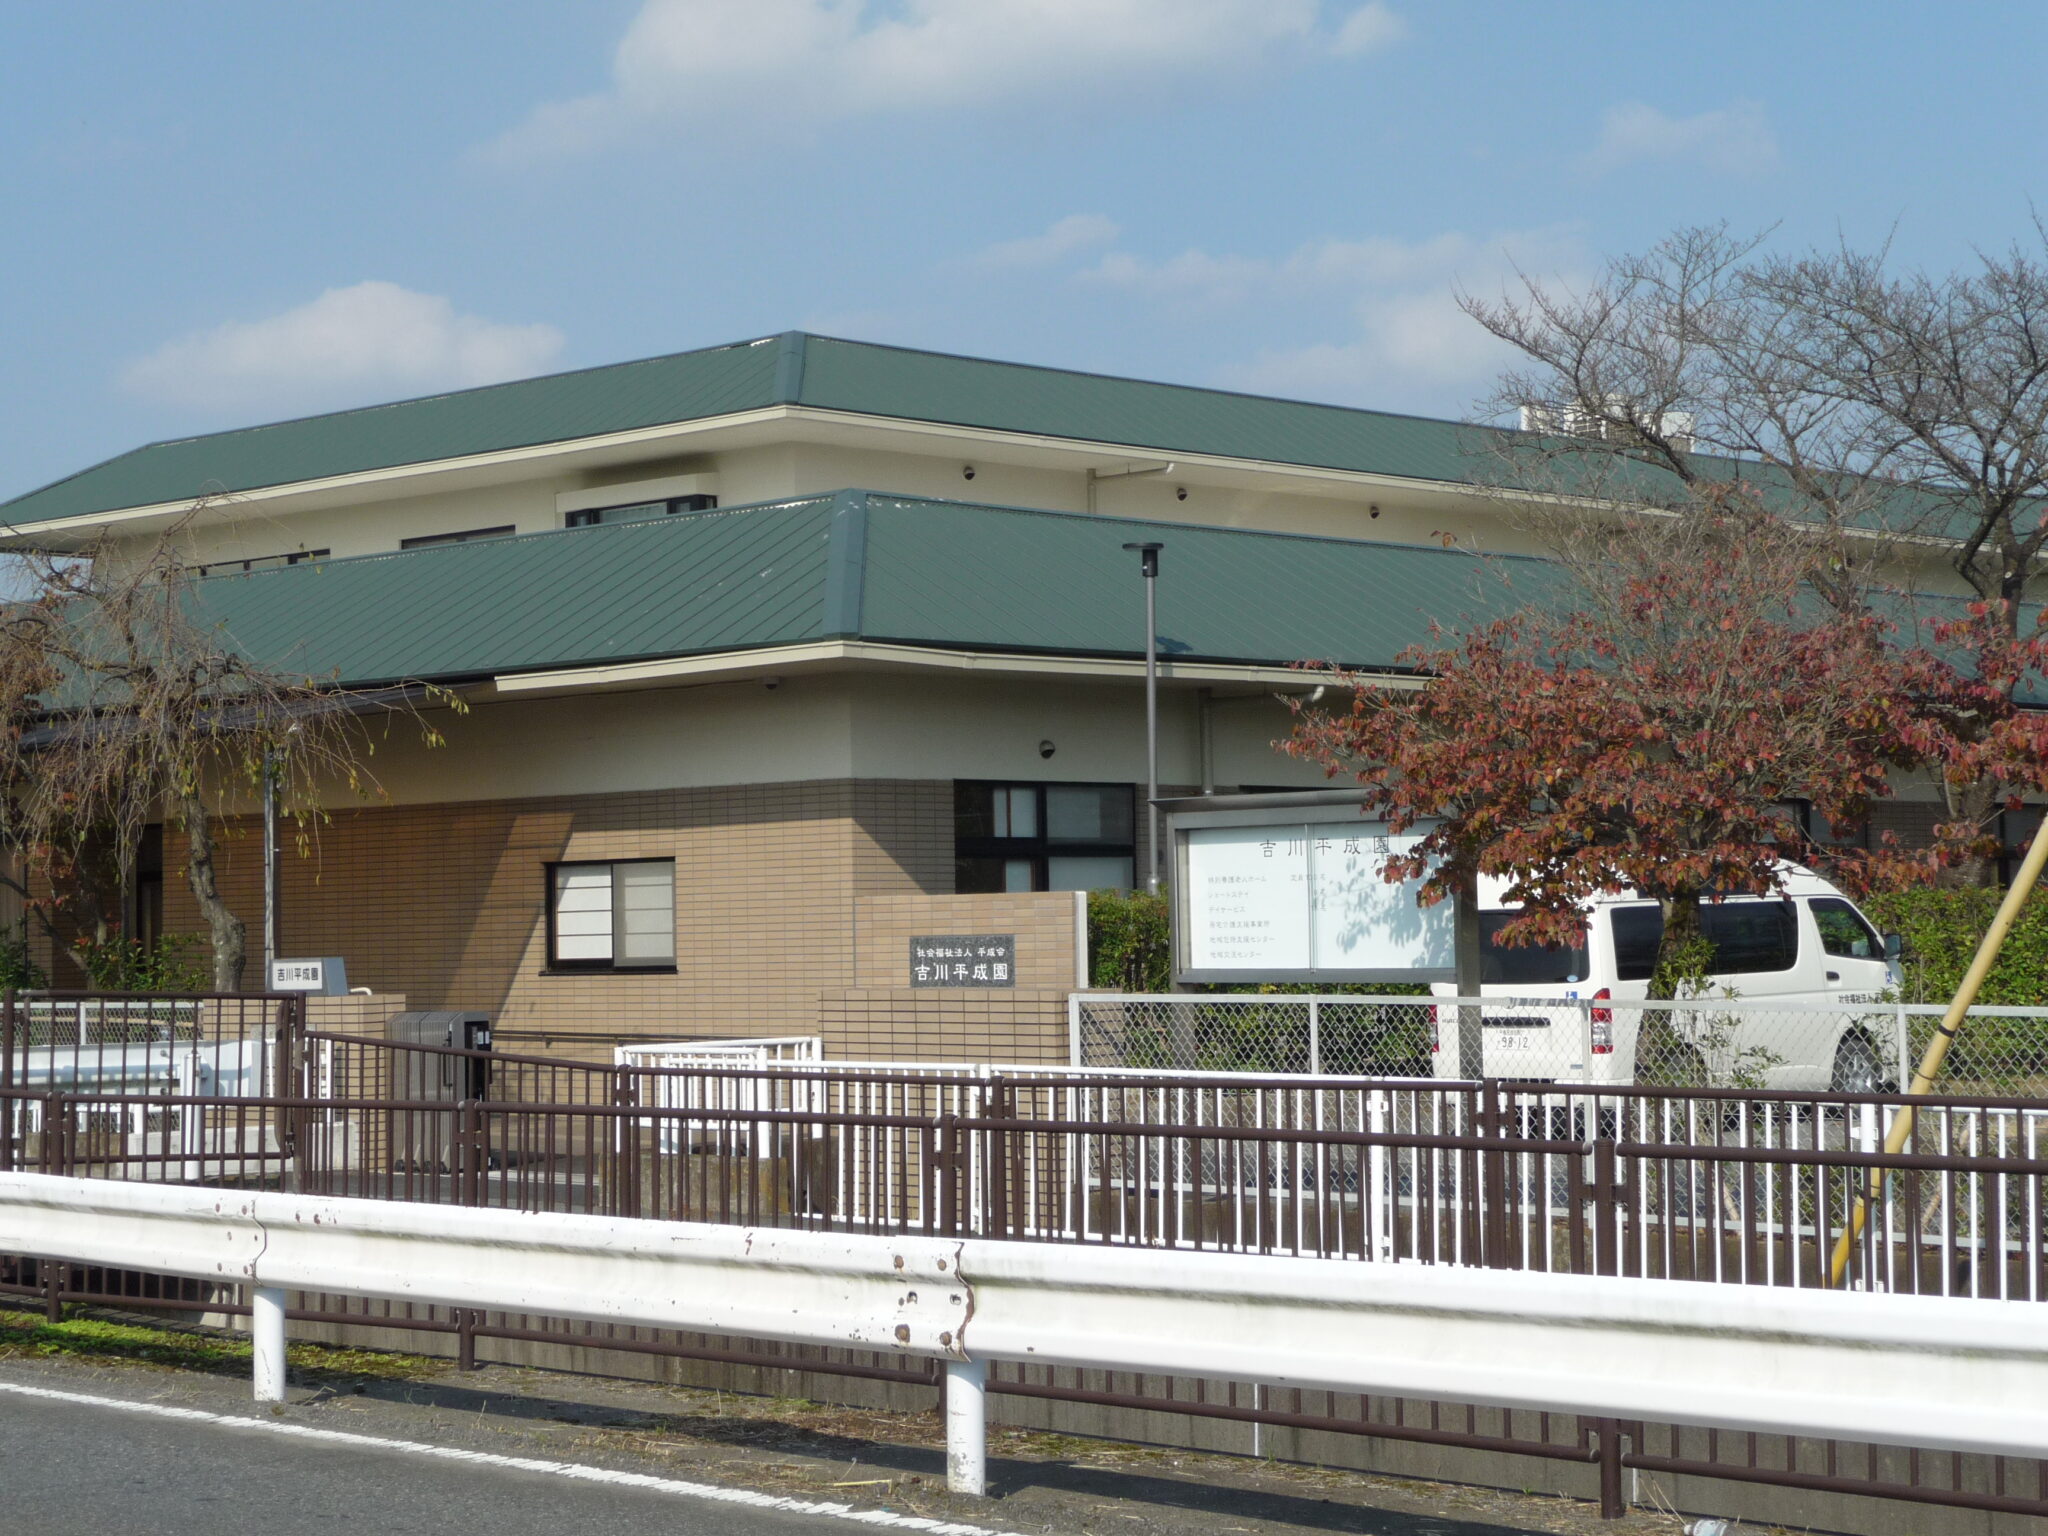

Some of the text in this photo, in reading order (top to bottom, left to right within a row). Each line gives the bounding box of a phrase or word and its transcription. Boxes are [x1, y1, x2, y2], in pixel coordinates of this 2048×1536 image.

[1259, 835, 1389, 857] 吉川平成園
[916, 946, 1005, 957] 社会福祉法人 平成会
[277, 967, 318, 981] 吉川平成園
[914, 963, 1007, 981] 吉川平成園
